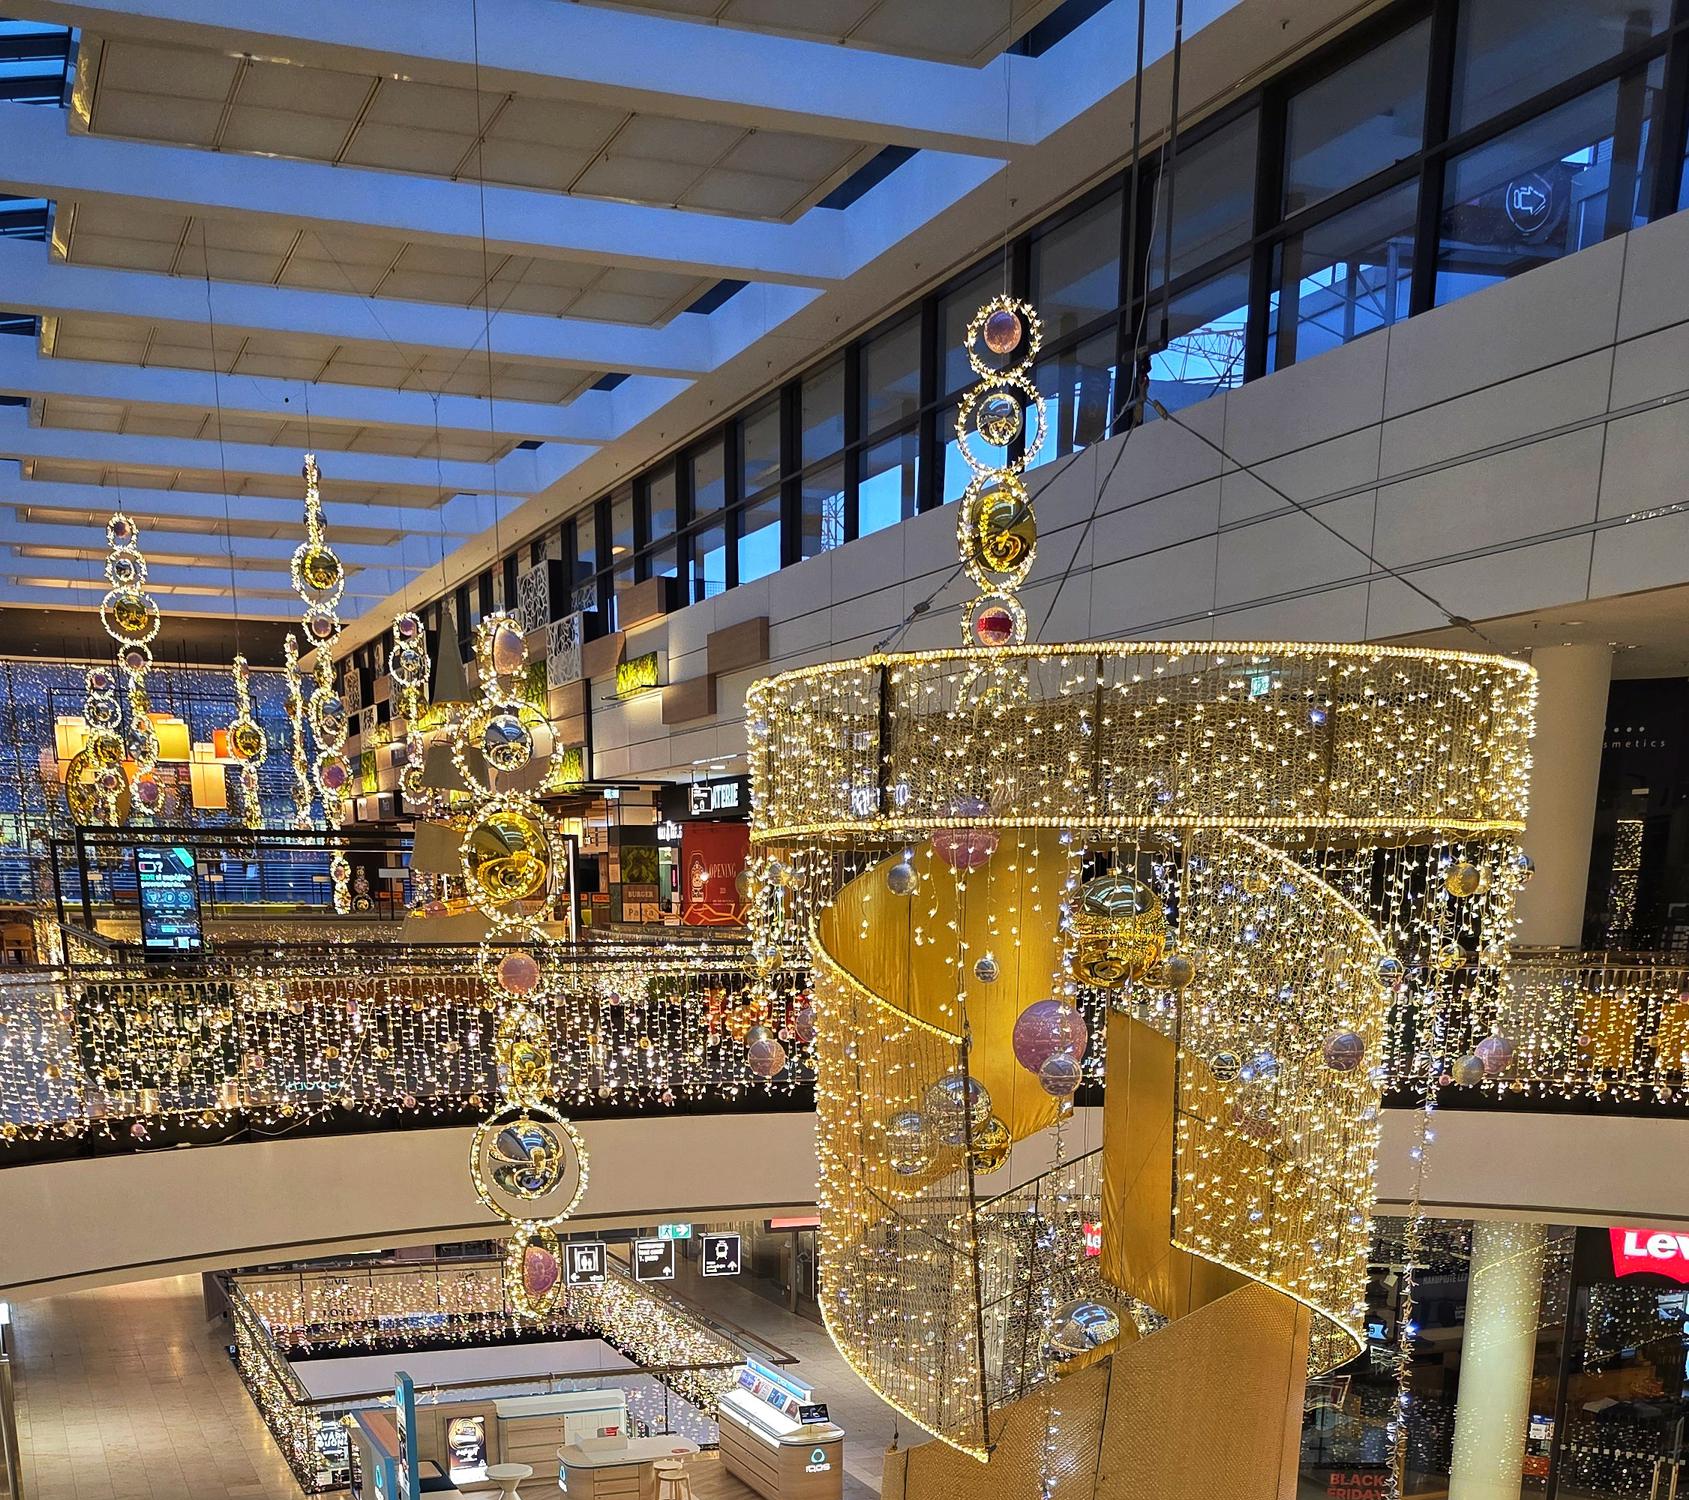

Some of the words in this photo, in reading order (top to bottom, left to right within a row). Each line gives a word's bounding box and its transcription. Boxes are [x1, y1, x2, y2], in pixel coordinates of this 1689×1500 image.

[1602, 738, 1667, 749] smetics
[709, 863, 737, 878] OPENING
[628, 908, 654, 916] Paa
[1086, 1233, 1101, 1248] Le
[1330, 1473, 1385, 1486] BLACK
[1327, 1488, 1385, 1500] FRIDAY
